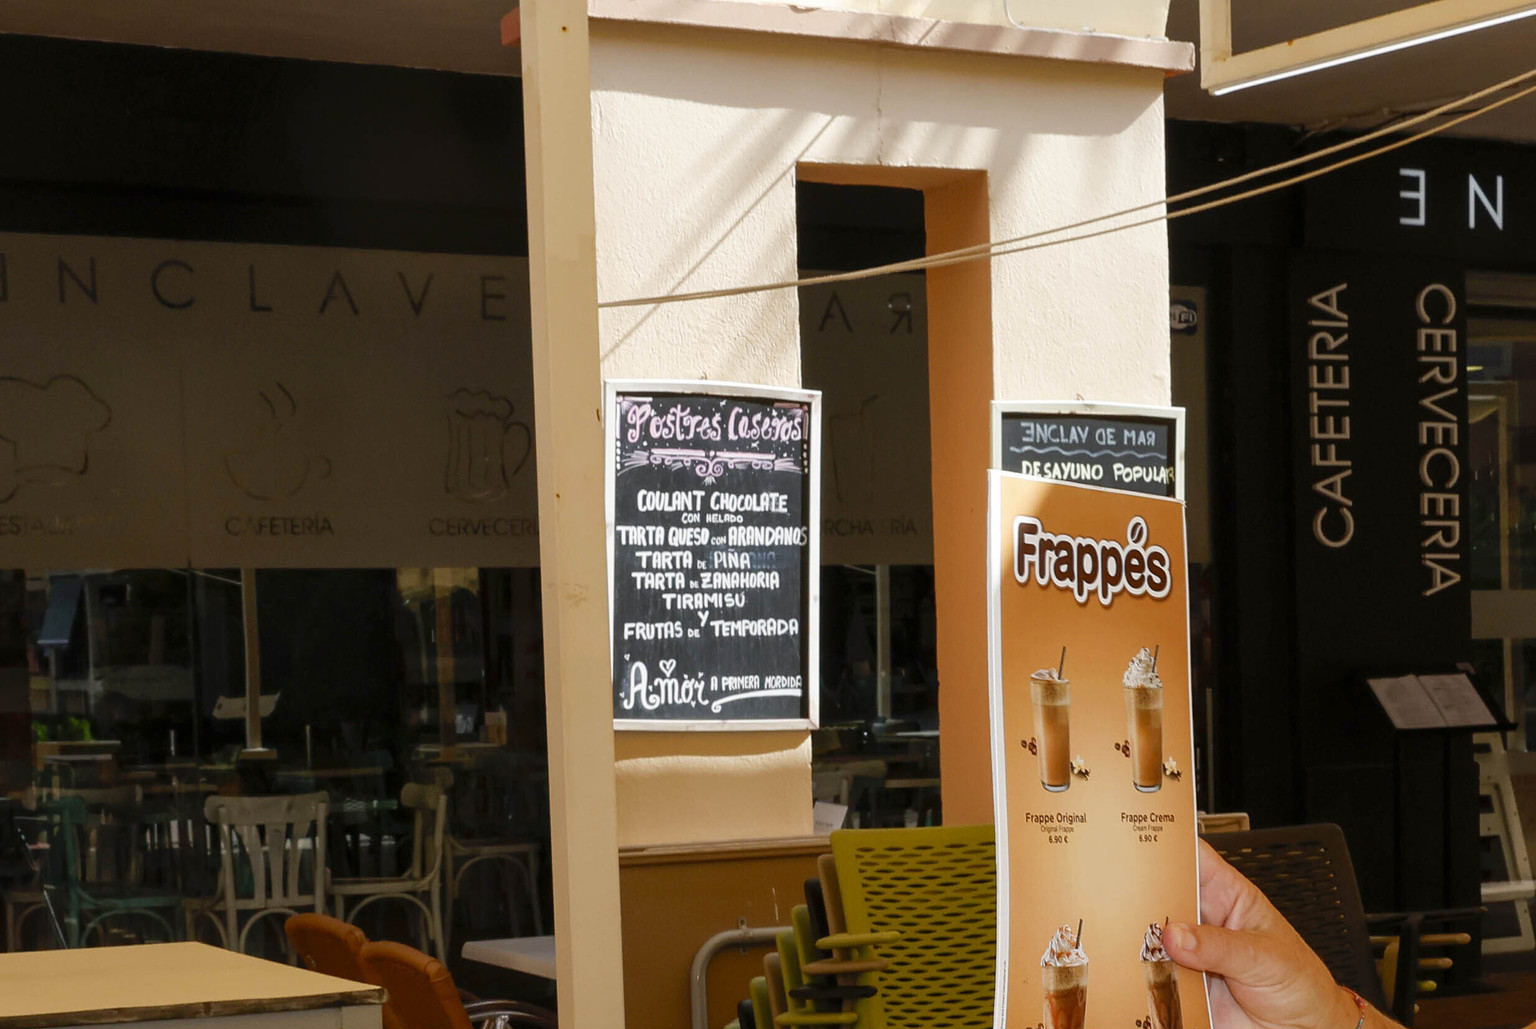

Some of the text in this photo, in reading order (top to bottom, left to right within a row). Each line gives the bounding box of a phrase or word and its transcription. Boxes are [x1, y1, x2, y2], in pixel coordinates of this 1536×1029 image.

[627, 404, 801, 443] Postres Caseros
[1307, 282, 1355, 548] CAFETERIA
[1123, 429, 1156, 446] MAR
[1415, 283, 1461, 597] CERVECERIA
[1021, 460, 1175, 485] DESAYUNO POPULAR
[637, 489, 788, 513] COULANT CHOCOLATE
[681, 512, 743, 524] CON HELADO
[616, 525, 808, 547] TARTA QUESO CON ARANDANOS
[635, 548, 751, 570] TARTA DE PIÑA
[1014, 517, 1171, 604] Frappés
[631, 571, 780, 590] TARTA DE ZANAHORIA
[662, 591, 746, 610] TIRAMISÚ
[623, 618, 799, 640] FRUTAS DE TEMPORADA
[623, 661, 802, 710] Amor A PRIMERA MORDIDA
[1025, 812, 1087, 825] Frappe Original
[1040, 825, 1058, 833] Original
[1121, 812, 1175, 824] Frappe Crema
[1048, 835, 1068, 844] 6.90 €
[1139, 834, 1158, 843] 6.90 €
